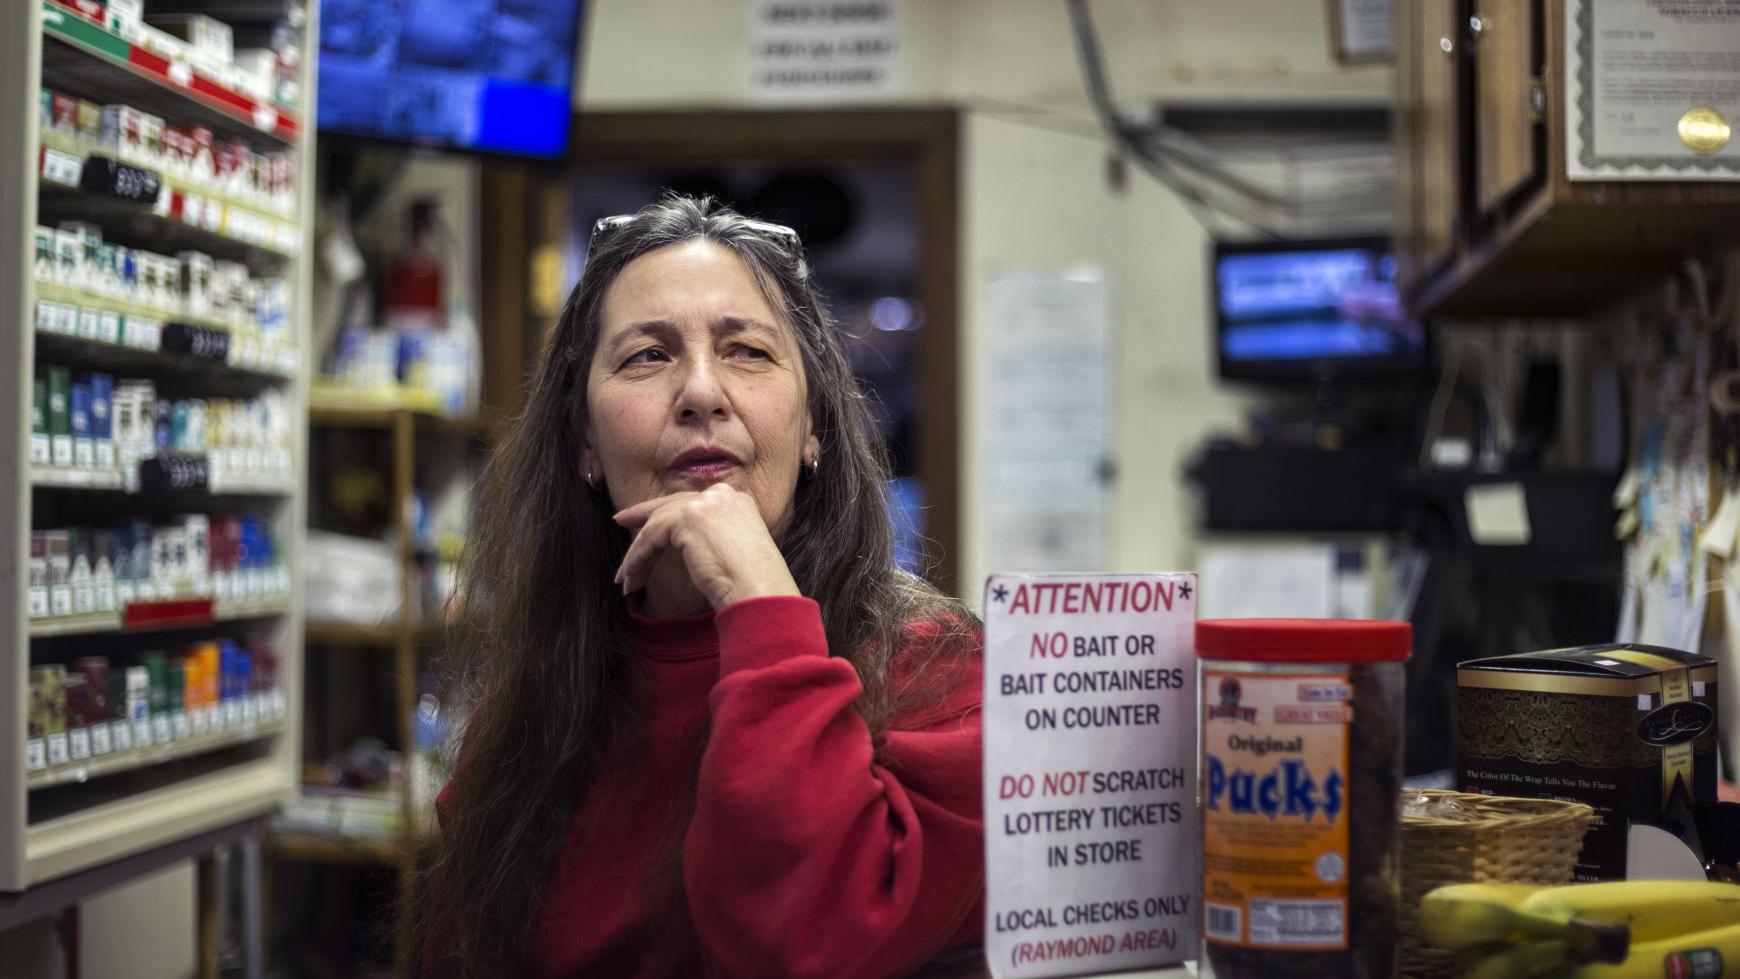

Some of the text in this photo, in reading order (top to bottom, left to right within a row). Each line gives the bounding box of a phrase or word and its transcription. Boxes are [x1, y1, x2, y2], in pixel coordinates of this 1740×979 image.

[1030, 631, 1155, 658] NO BAIT OR
[1001, 668, 1184, 696] BAIT CONTAINERS
[1025, 704, 1160, 730] ON COUNTER
[1227, 734, 1303, 757] Original
[999, 768, 1184, 800] DO NOT SCRATCH
[1207, 751, 1344, 824] Pucks
[1466, 769, 1616, 790] The Color Of The Wrap Tells You The Flavor
[1004, 802, 1182, 835] LOTTERY TICKETS
[1048, 840, 1142, 867] IN STORE
[996, 894, 1191, 932] LOCAL CHECKS ONLY
[1011, 928, 1177, 967] (RAYMOND AREA)
